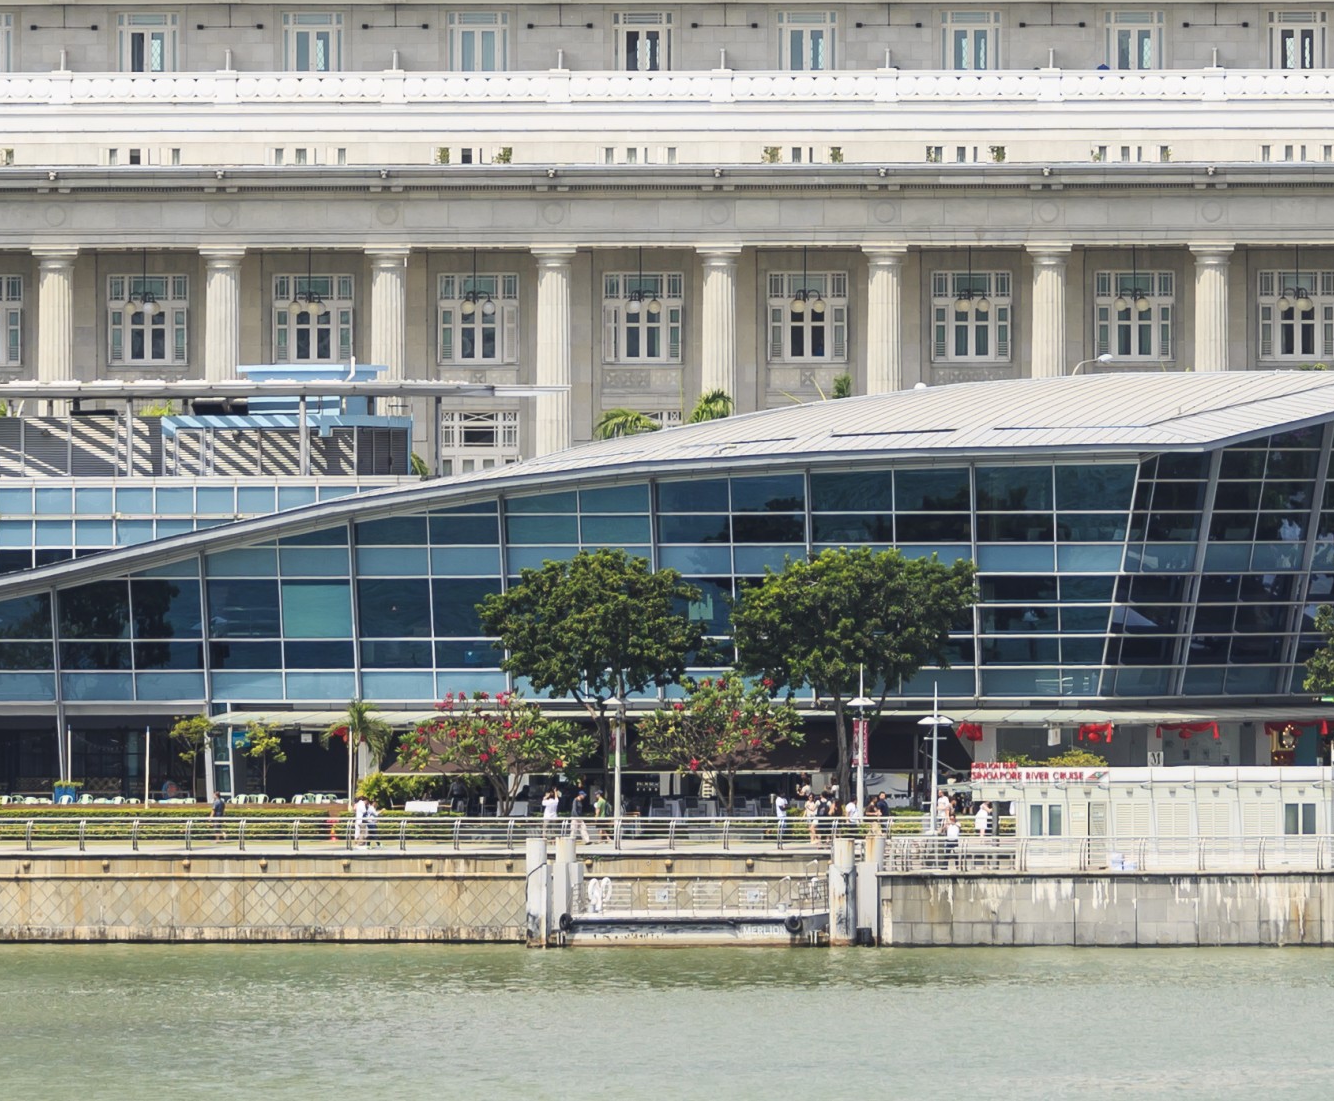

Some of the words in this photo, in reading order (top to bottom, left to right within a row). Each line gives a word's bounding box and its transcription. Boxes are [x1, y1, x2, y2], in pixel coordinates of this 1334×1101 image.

[971, 772, 1021, 780] SINGAPORE
[1026, 772, 1048, 780] RIVER
[1053, 772, 1083, 780] CRUISE
[743, 925, 786, 935] MERLION
